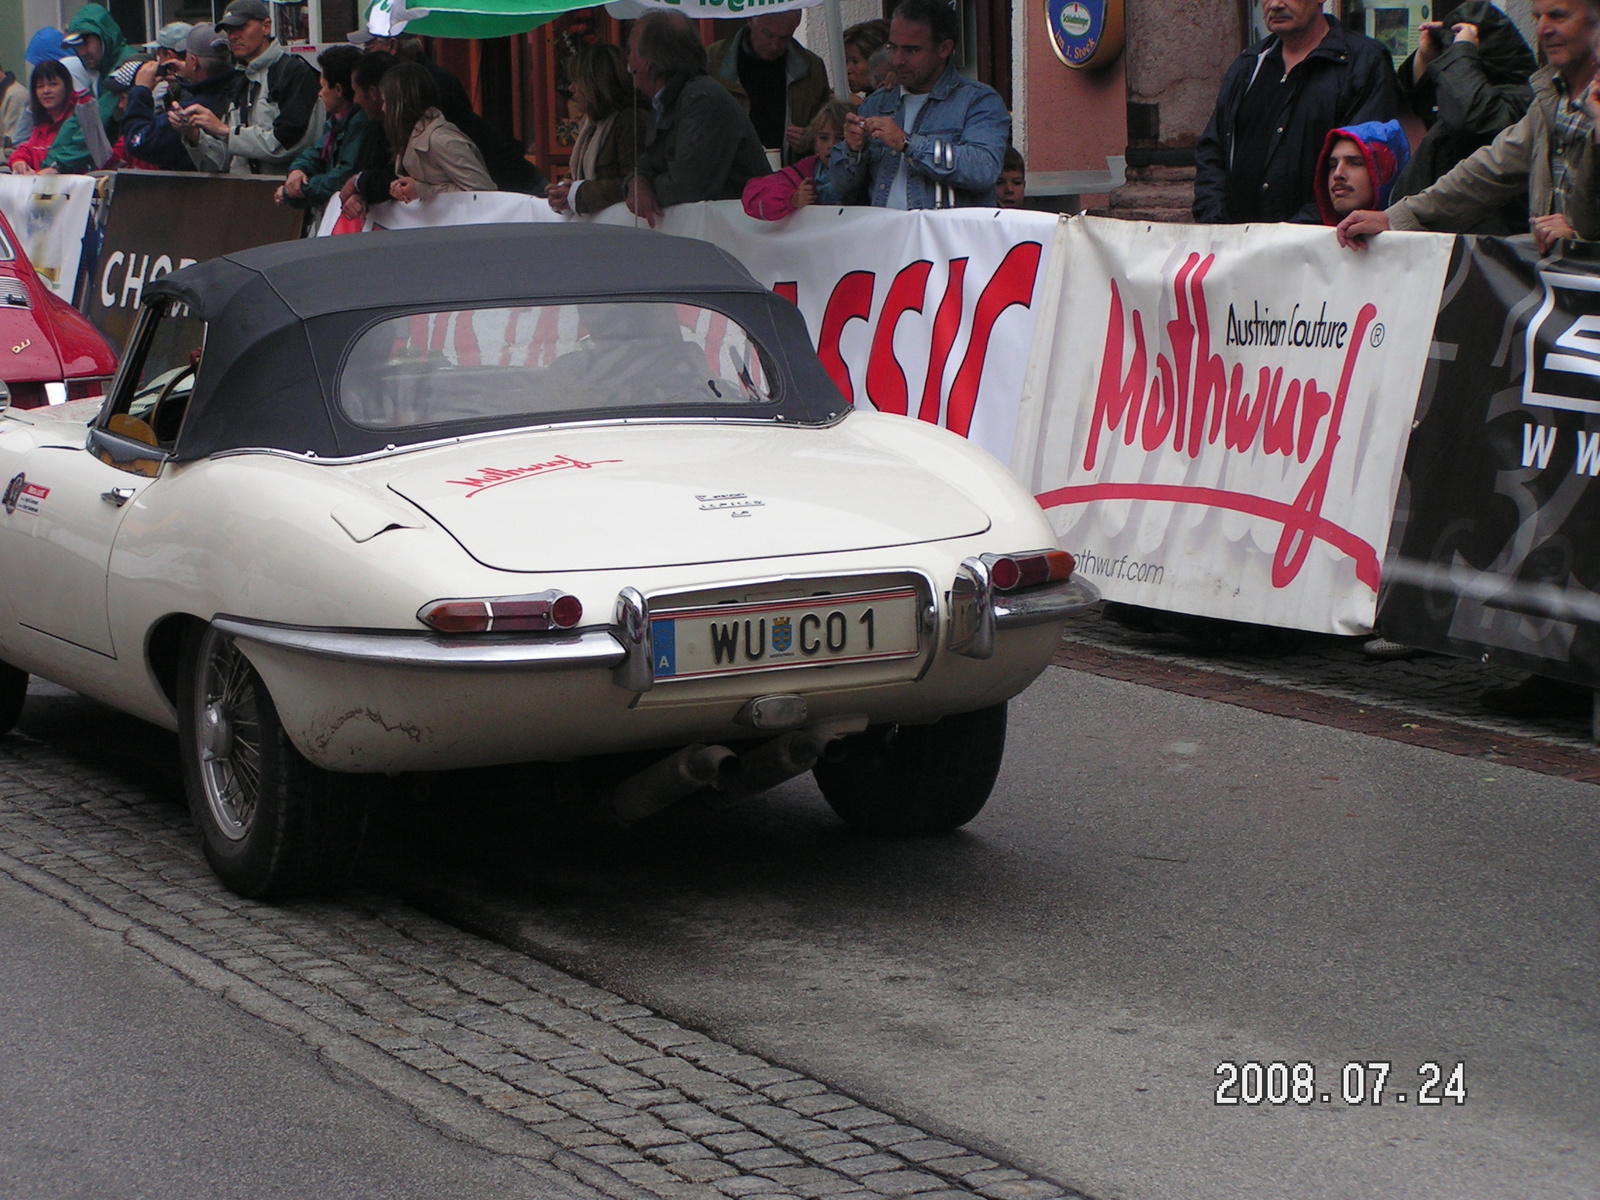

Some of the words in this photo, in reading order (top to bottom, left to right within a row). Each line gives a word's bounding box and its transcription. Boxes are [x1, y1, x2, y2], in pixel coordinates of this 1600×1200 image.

[1074, 37, 1096, 59] Stock
[1226, 300, 1287, 347] Austrian
[1288, 301, 1348, 349] Couture
[1083, 252, 1377, 588] Mothwurf
[658, 655, 670, 668] A
[710, 617, 765, 665] WU
